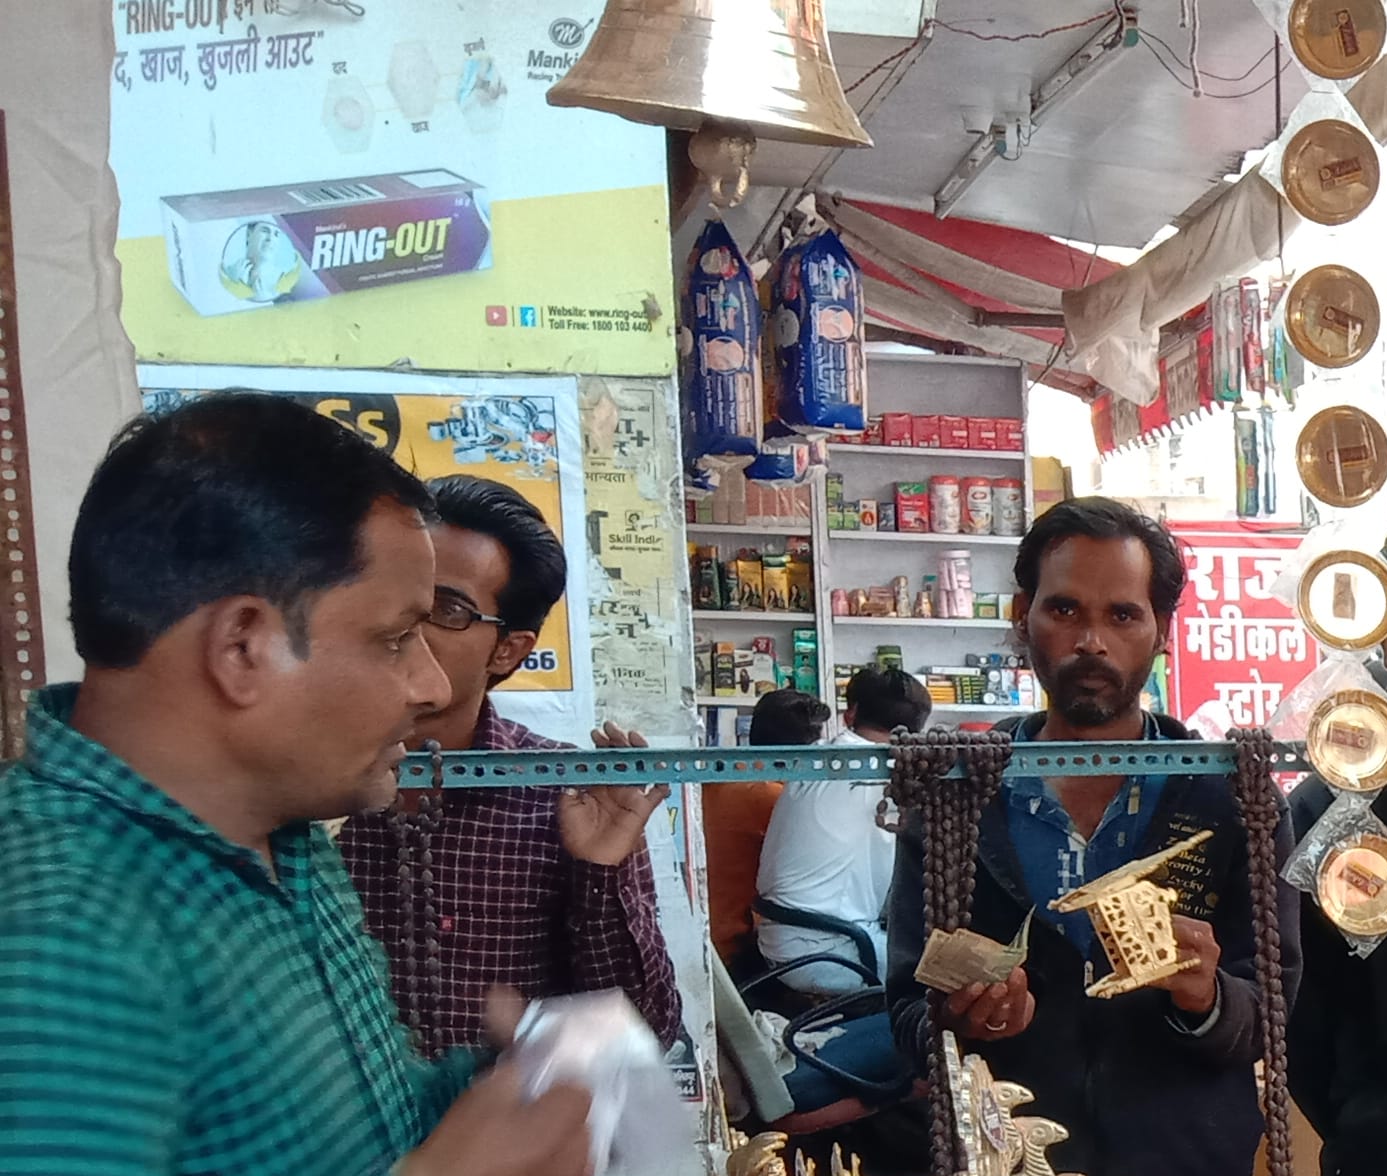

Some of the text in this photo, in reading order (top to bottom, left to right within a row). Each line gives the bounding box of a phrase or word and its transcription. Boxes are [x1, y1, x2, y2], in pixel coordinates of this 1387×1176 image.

[197, 23, 261, 91] खुजली
[311, 217, 452, 270] RING-OUT
[548, 306, 587, 318] Website:
[549, 319, 565, 330] Toll
[567, 320, 589, 330] Free:
[616, 321, 630, 331] 103
[609, 534, 632, 544] Skill
[1184, 604, 1306, 662] मेडीकल
